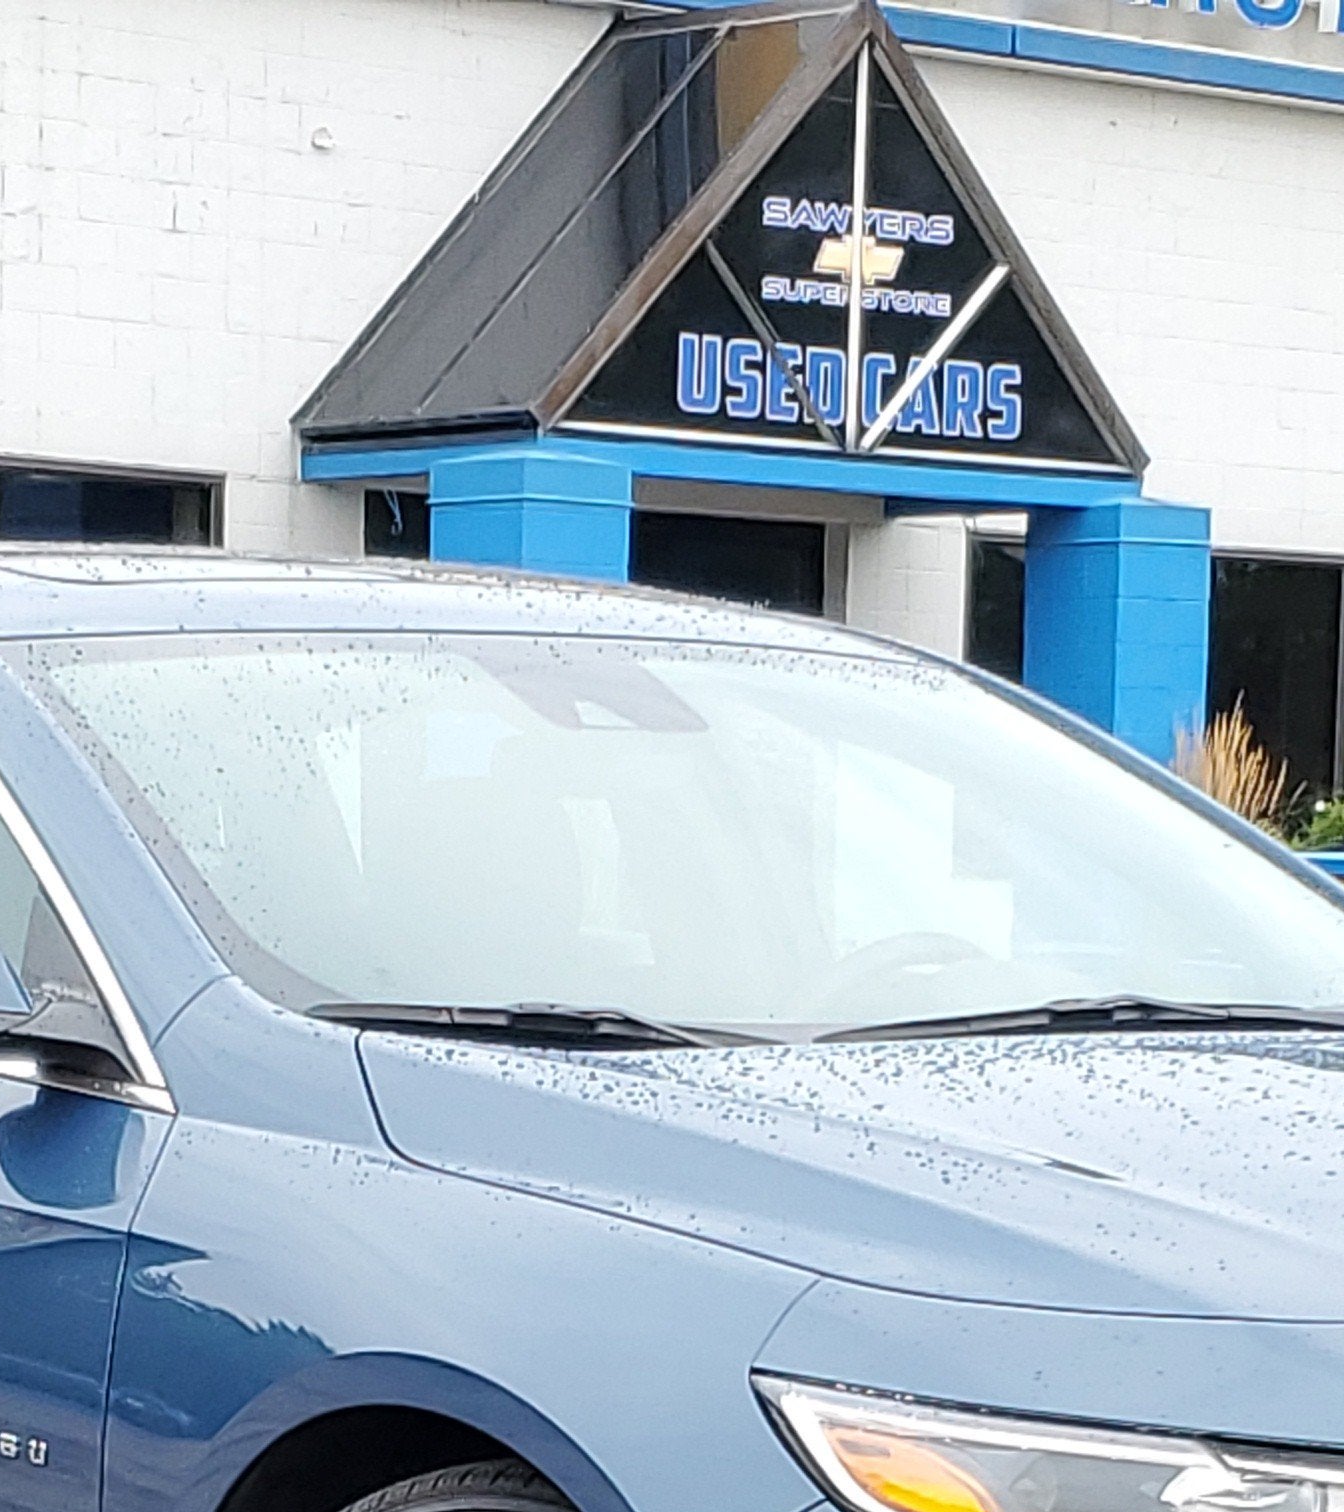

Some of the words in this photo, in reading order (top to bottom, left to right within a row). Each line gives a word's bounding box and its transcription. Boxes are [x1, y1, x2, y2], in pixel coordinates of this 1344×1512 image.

[762, 196, 954, 246] SAWYERS
[761, 274, 952, 317] SUPESTORE
[676, 331, 847, 427] USED
[861, 352, 1022, 441] CARS
